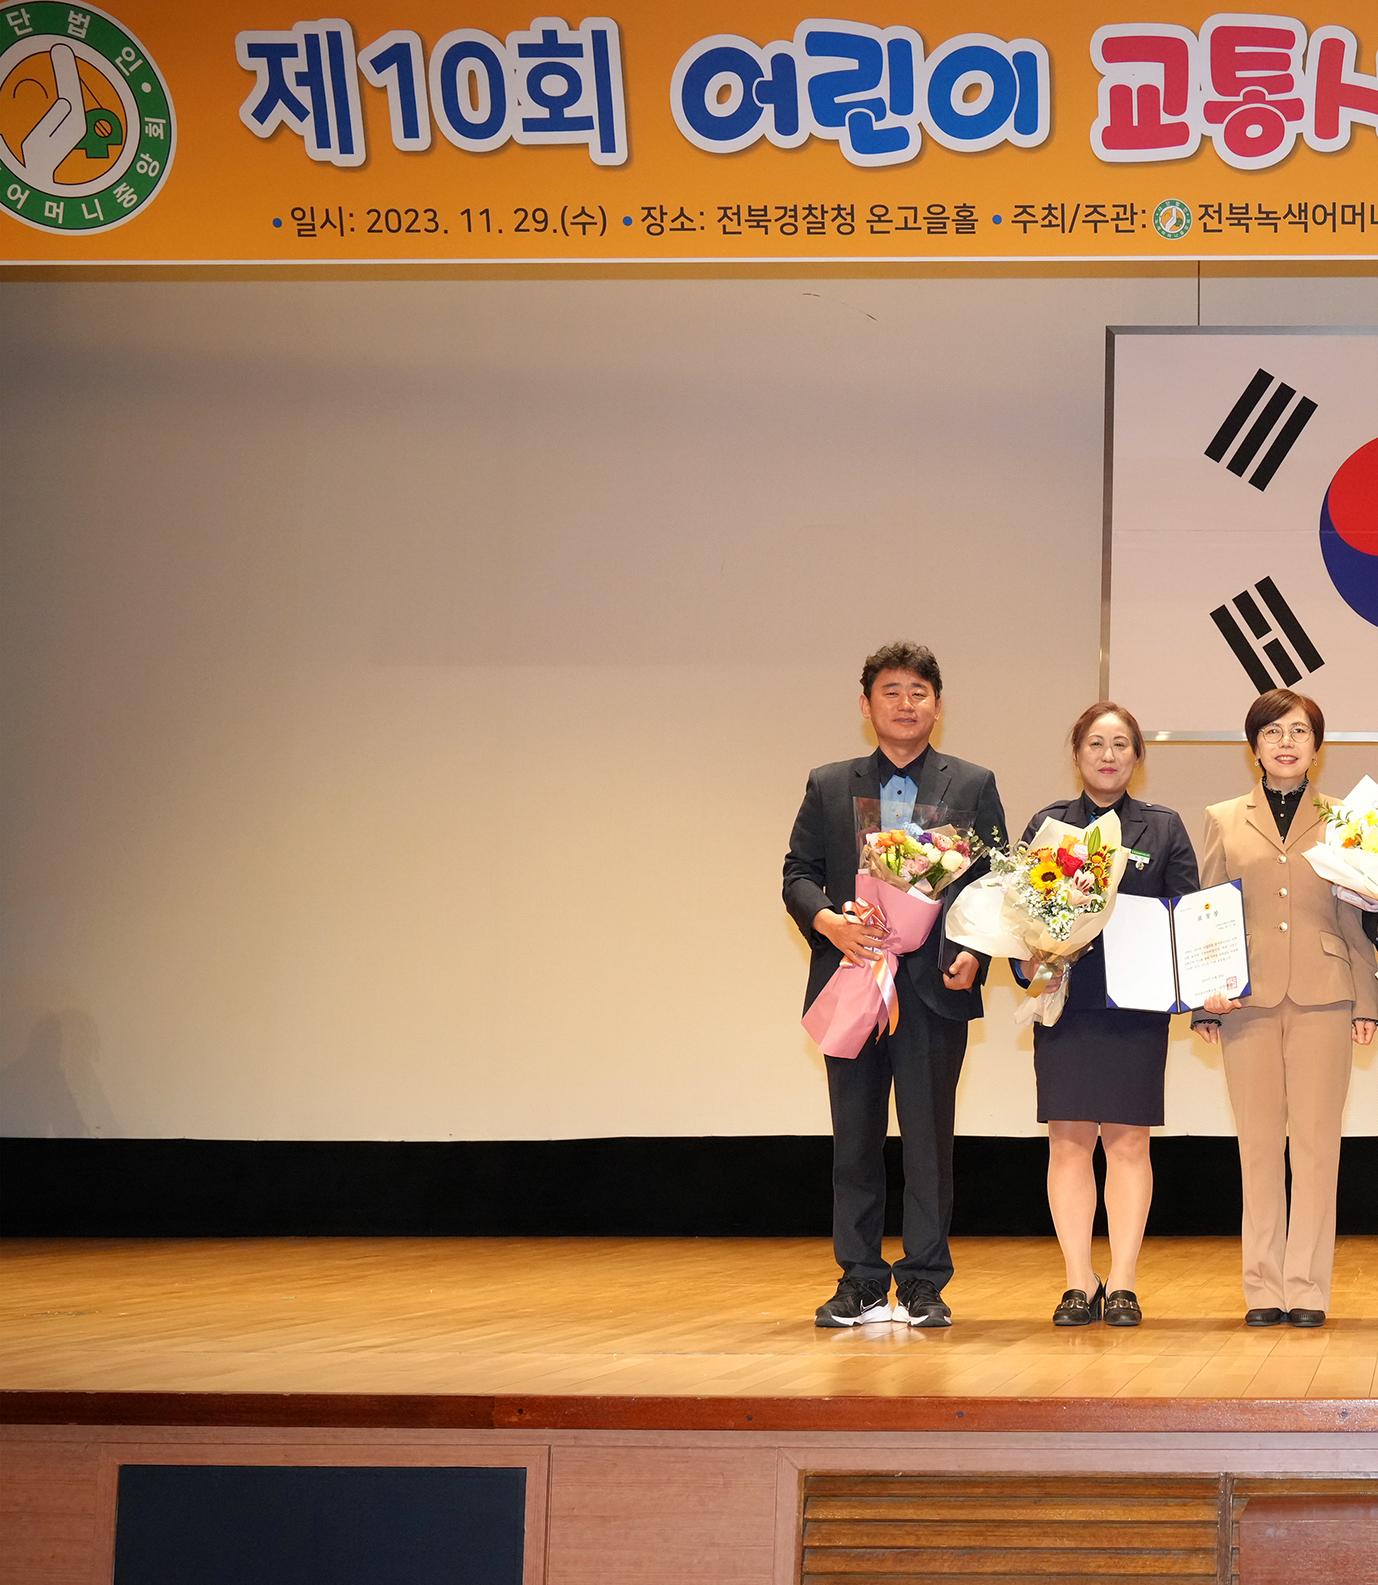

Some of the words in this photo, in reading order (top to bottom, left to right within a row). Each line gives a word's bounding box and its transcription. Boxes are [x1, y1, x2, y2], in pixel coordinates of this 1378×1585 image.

[245, 27, 619, 156] 제10회
[680, 30, 1040, 156] 어린이
[0, 117, 166, 224] 어머니중앙회
[289, 205, 355, 237] 일시:
[365, 207, 450, 235] 2023.
[460, 207, 503, 234] 11.
[512, 205, 607, 237] 29.(수)
[639, 204, 705, 236] 장소:
[716, 203, 855, 236] 전북경찰청
[865, 202, 979, 235] 온고을홀
[1010, 202, 1147, 234] 주최/주관:
